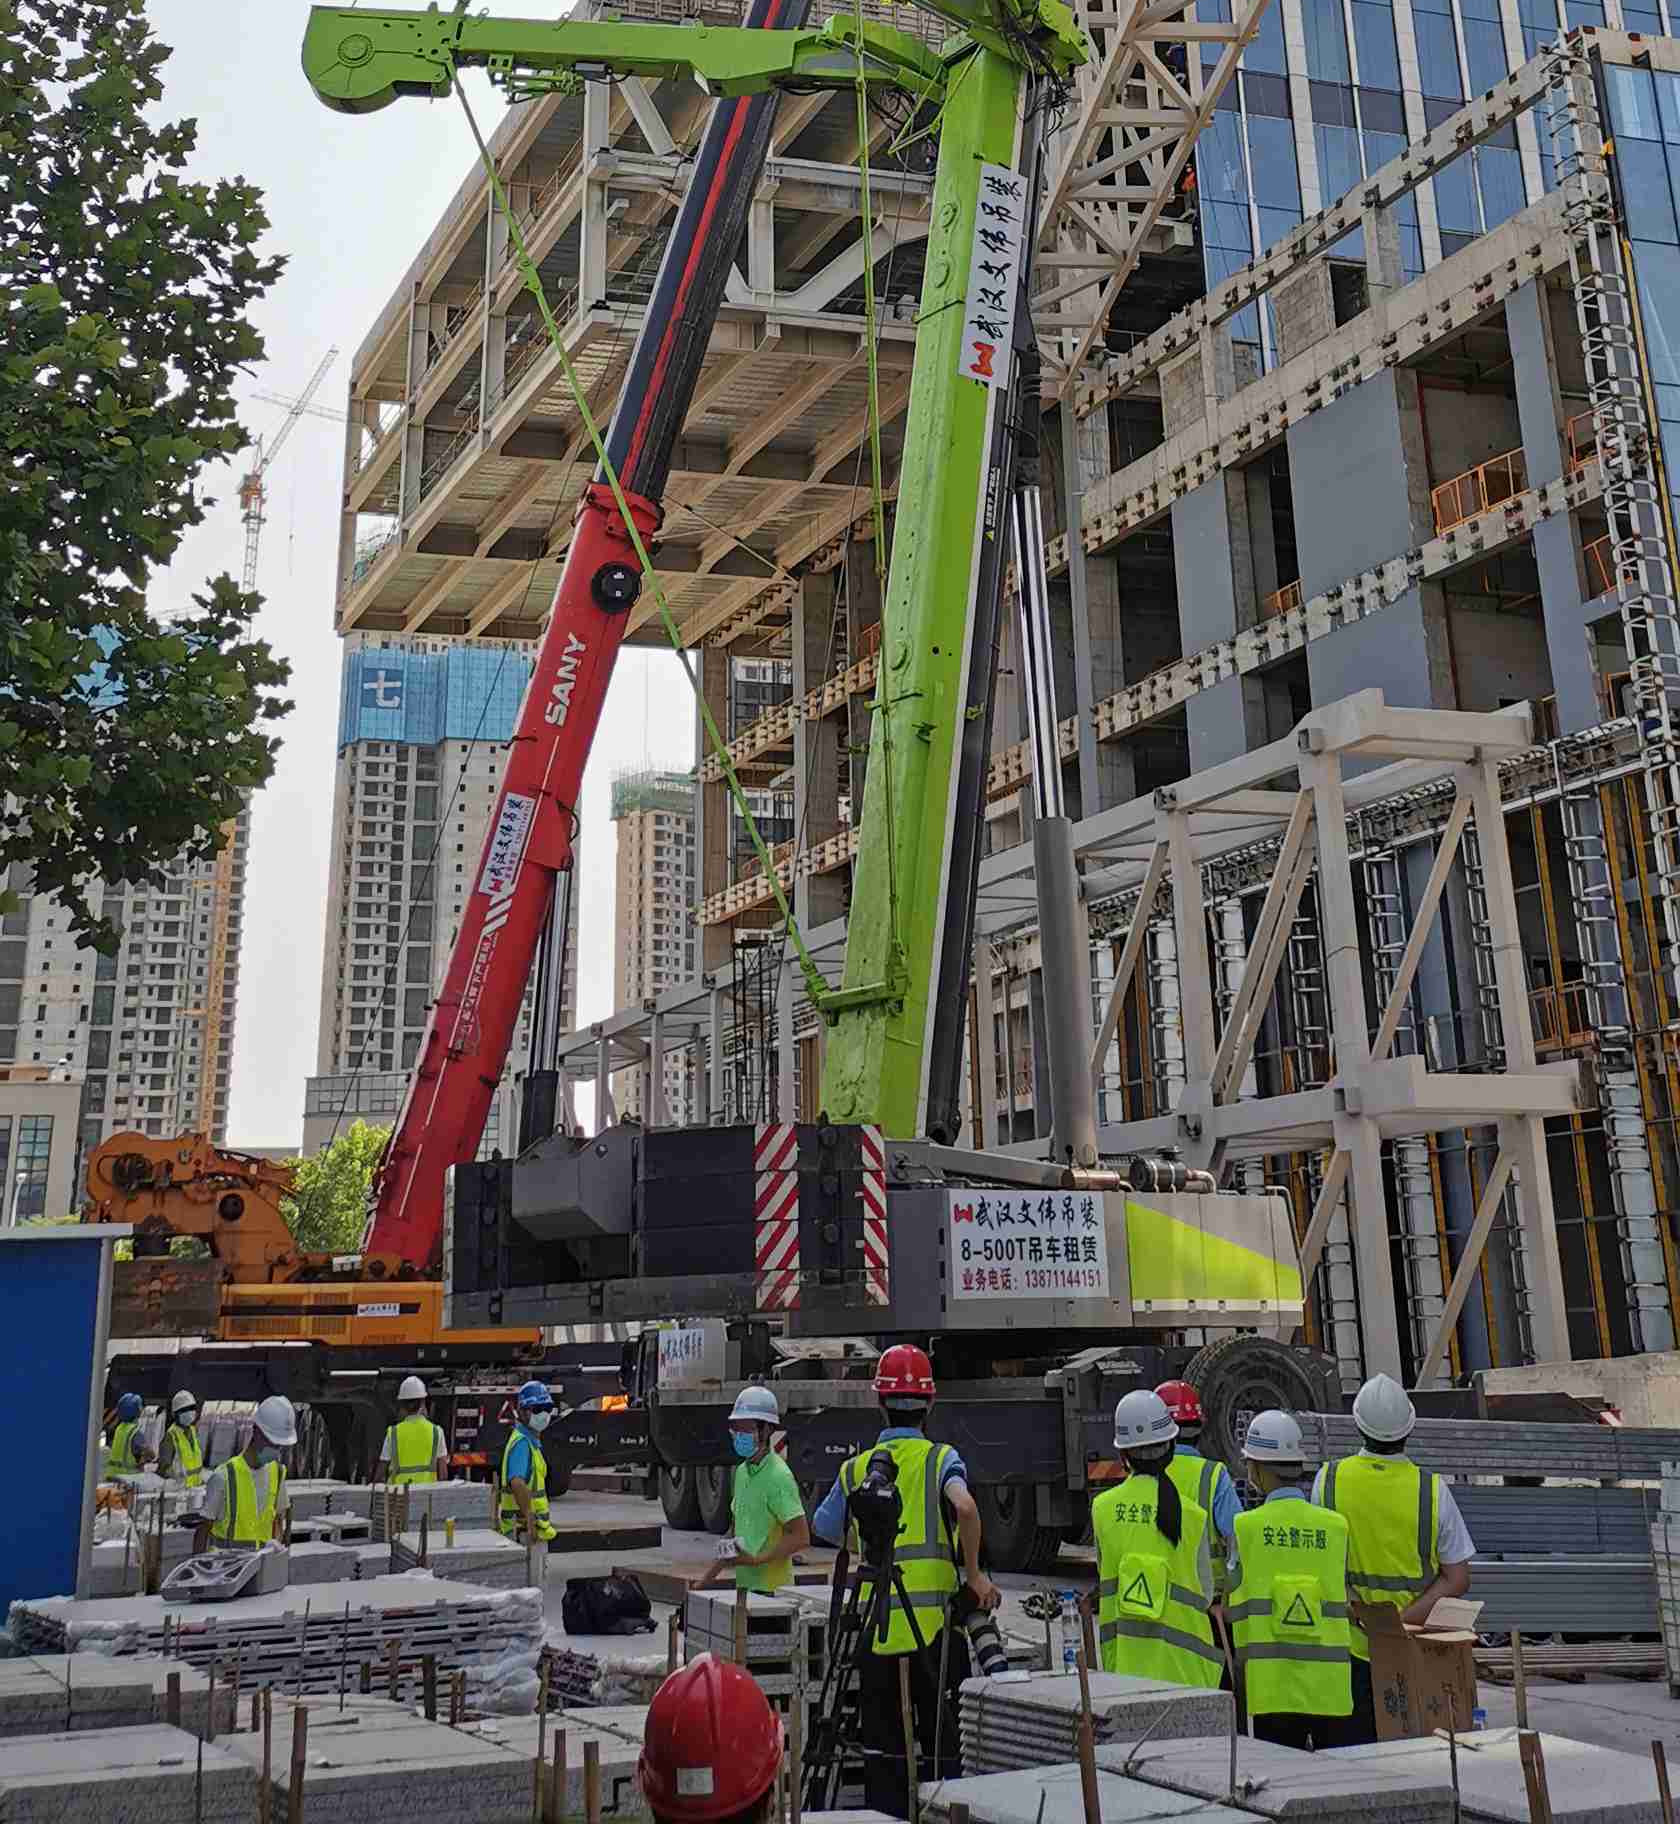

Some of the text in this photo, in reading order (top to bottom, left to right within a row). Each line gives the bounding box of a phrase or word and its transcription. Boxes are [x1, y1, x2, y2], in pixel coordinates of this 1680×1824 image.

[969, 176, 1022, 340] 武汉文伟吊装
[363, 670, 402, 707] 七
[545, 633, 586, 727] SANY
[975, 1196, 1098, 1230] 武汉文伟吊装
[961, 1236, 1097, 1263] 8-500T吊车租赁
[1025, 1269, 1101, 1288] 13871144151
[1115, 1502, 1158, 1524] 安全警
[1263, 1526, 1328, 1550] 安全警示服
